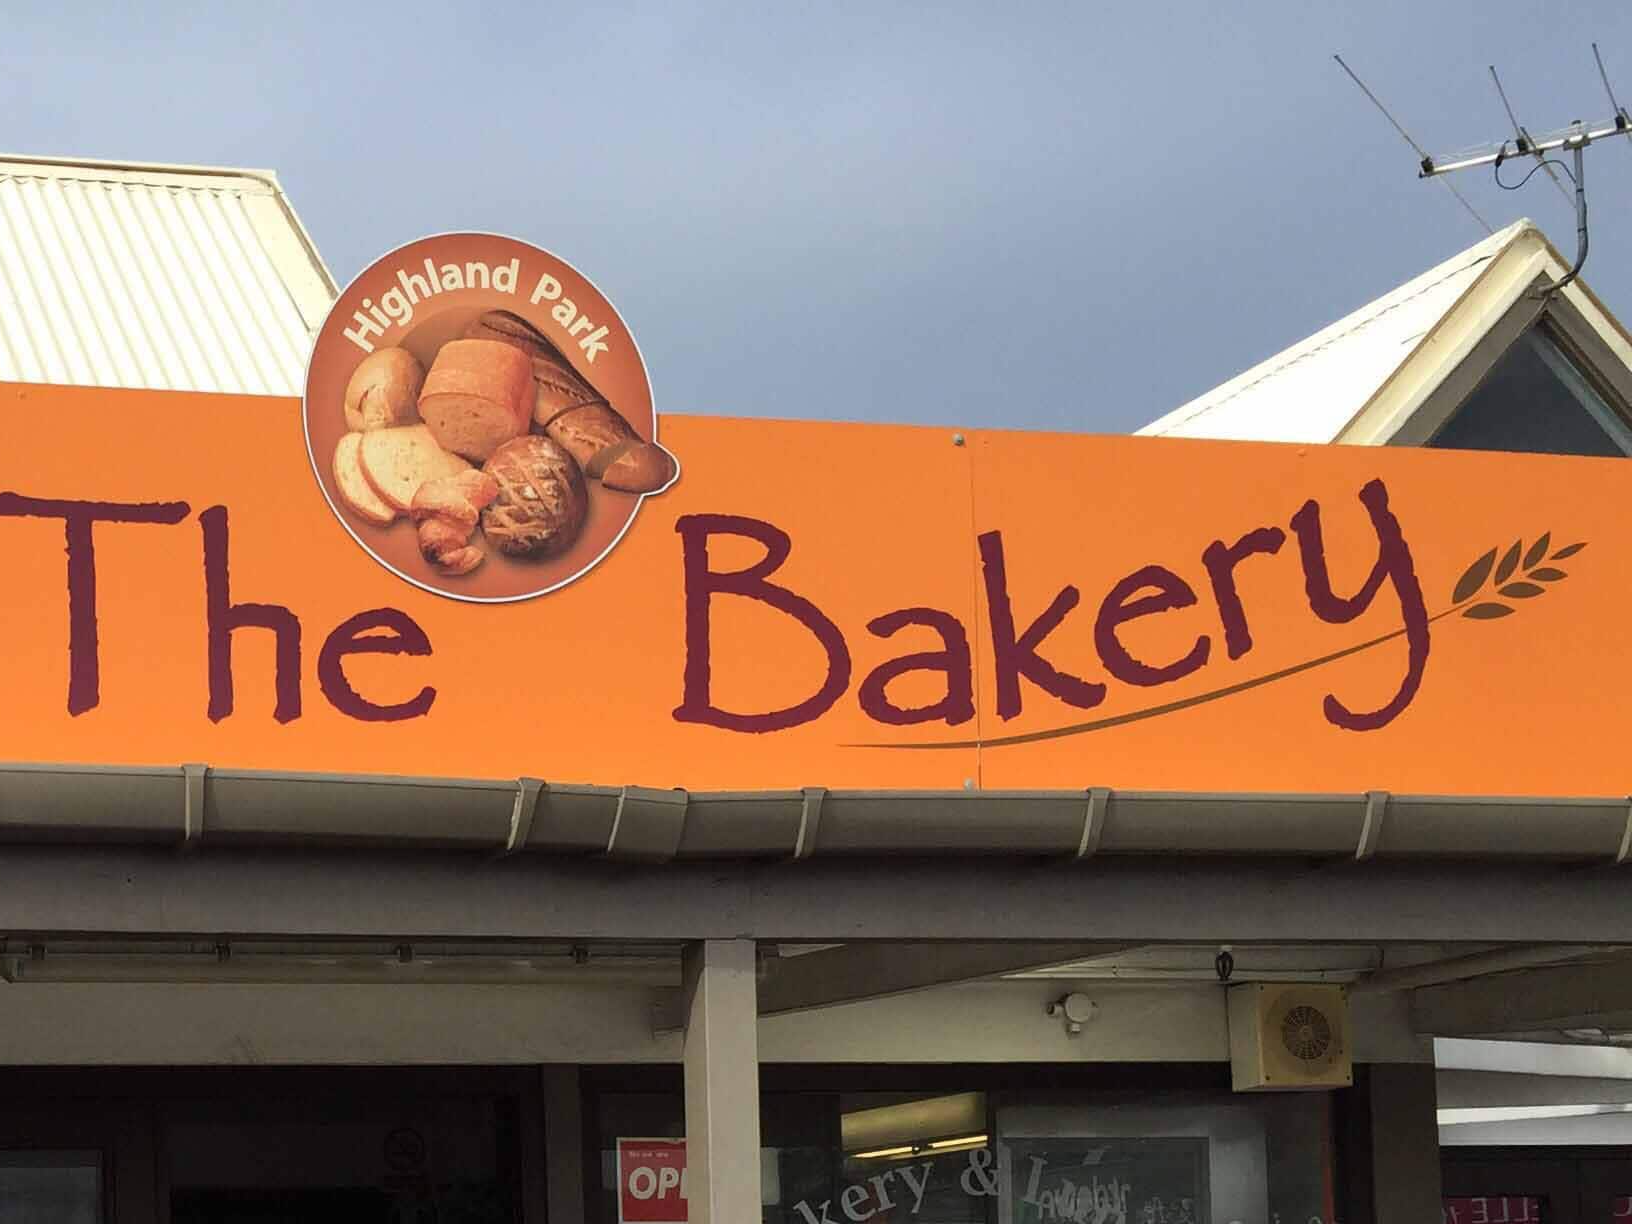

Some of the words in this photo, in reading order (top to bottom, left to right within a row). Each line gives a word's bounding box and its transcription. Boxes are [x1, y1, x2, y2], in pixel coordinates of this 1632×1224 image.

[343, 257, 520, 353] Highland
[530, 272, 609, 363] Park
[672, 477, 1432, 733] Bakery
[628, 1166, 688, 1200] OP
[960, 1150, 1000, 1197] &
